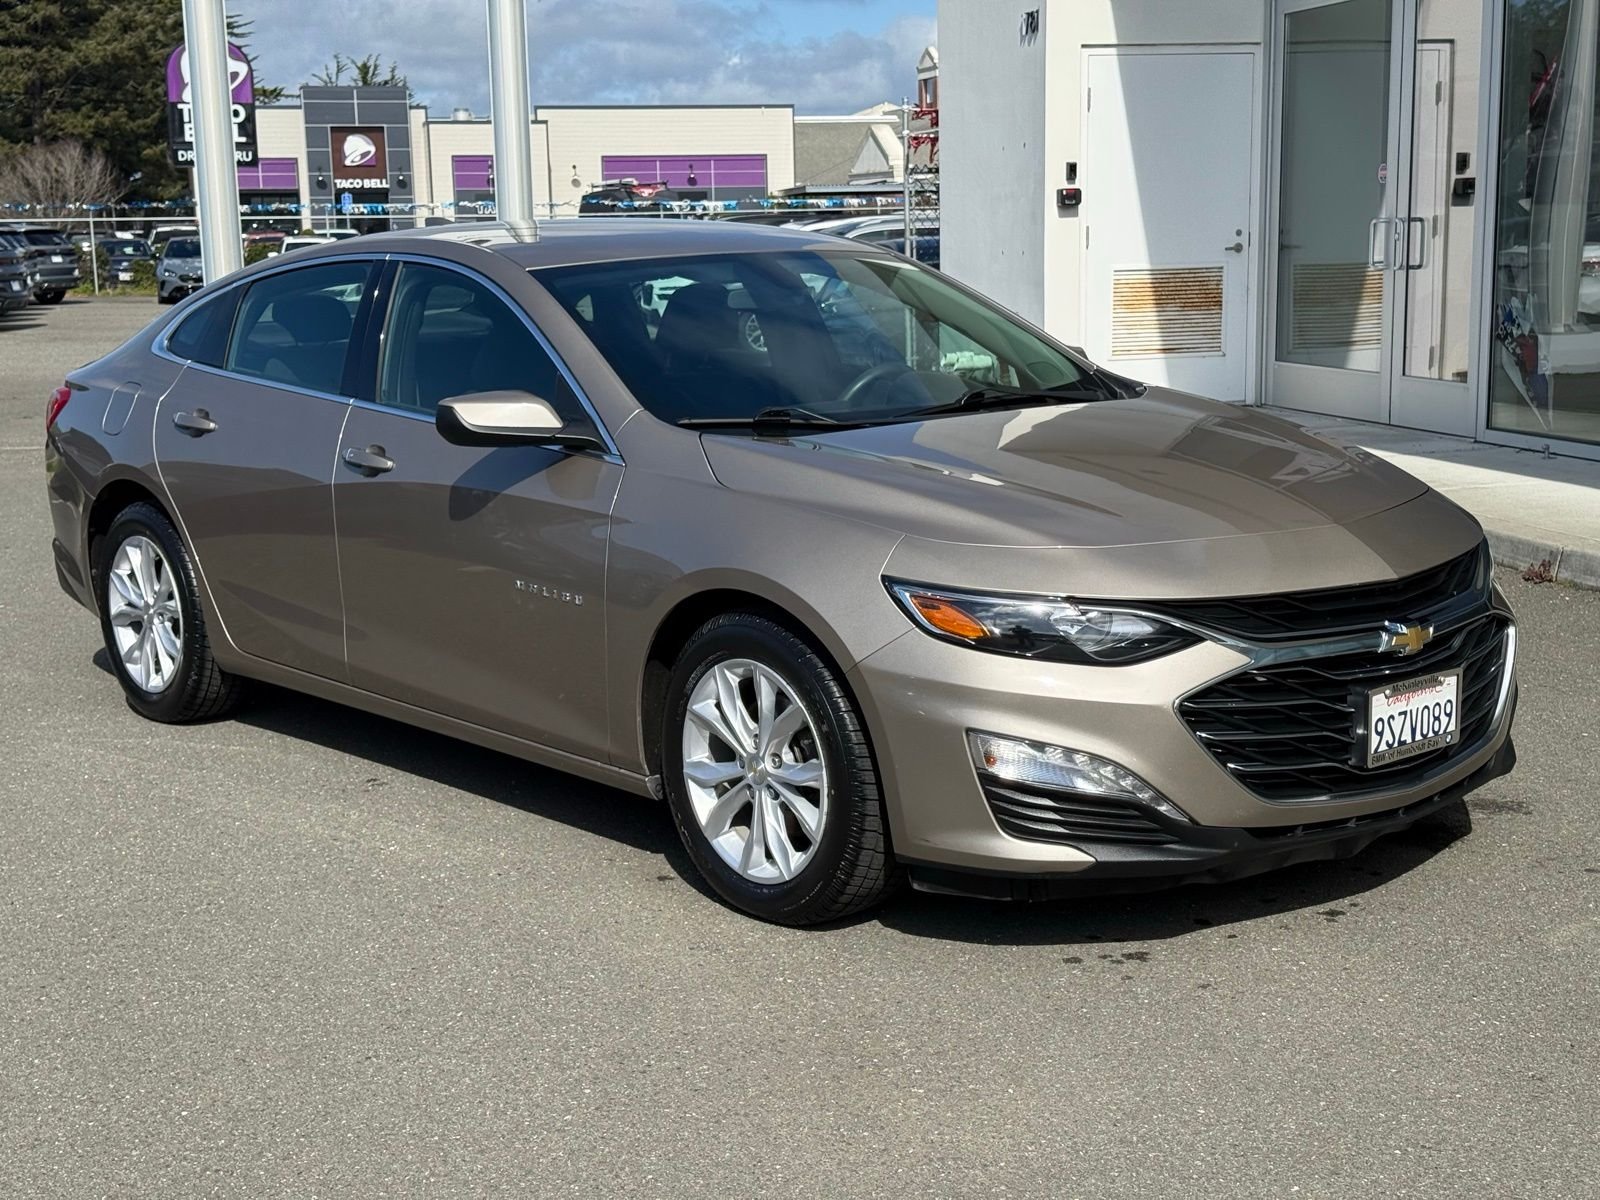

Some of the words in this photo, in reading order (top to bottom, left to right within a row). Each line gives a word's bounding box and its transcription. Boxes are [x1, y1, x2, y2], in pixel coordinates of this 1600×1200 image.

[177, 103, 246, 123] TO
[184, 122, 247, 142] BL
[334, 178, 362, 189] TACO
[363, 178, 390, 188] BELL
[1373, 699, 1454, 754] 9SZV089
